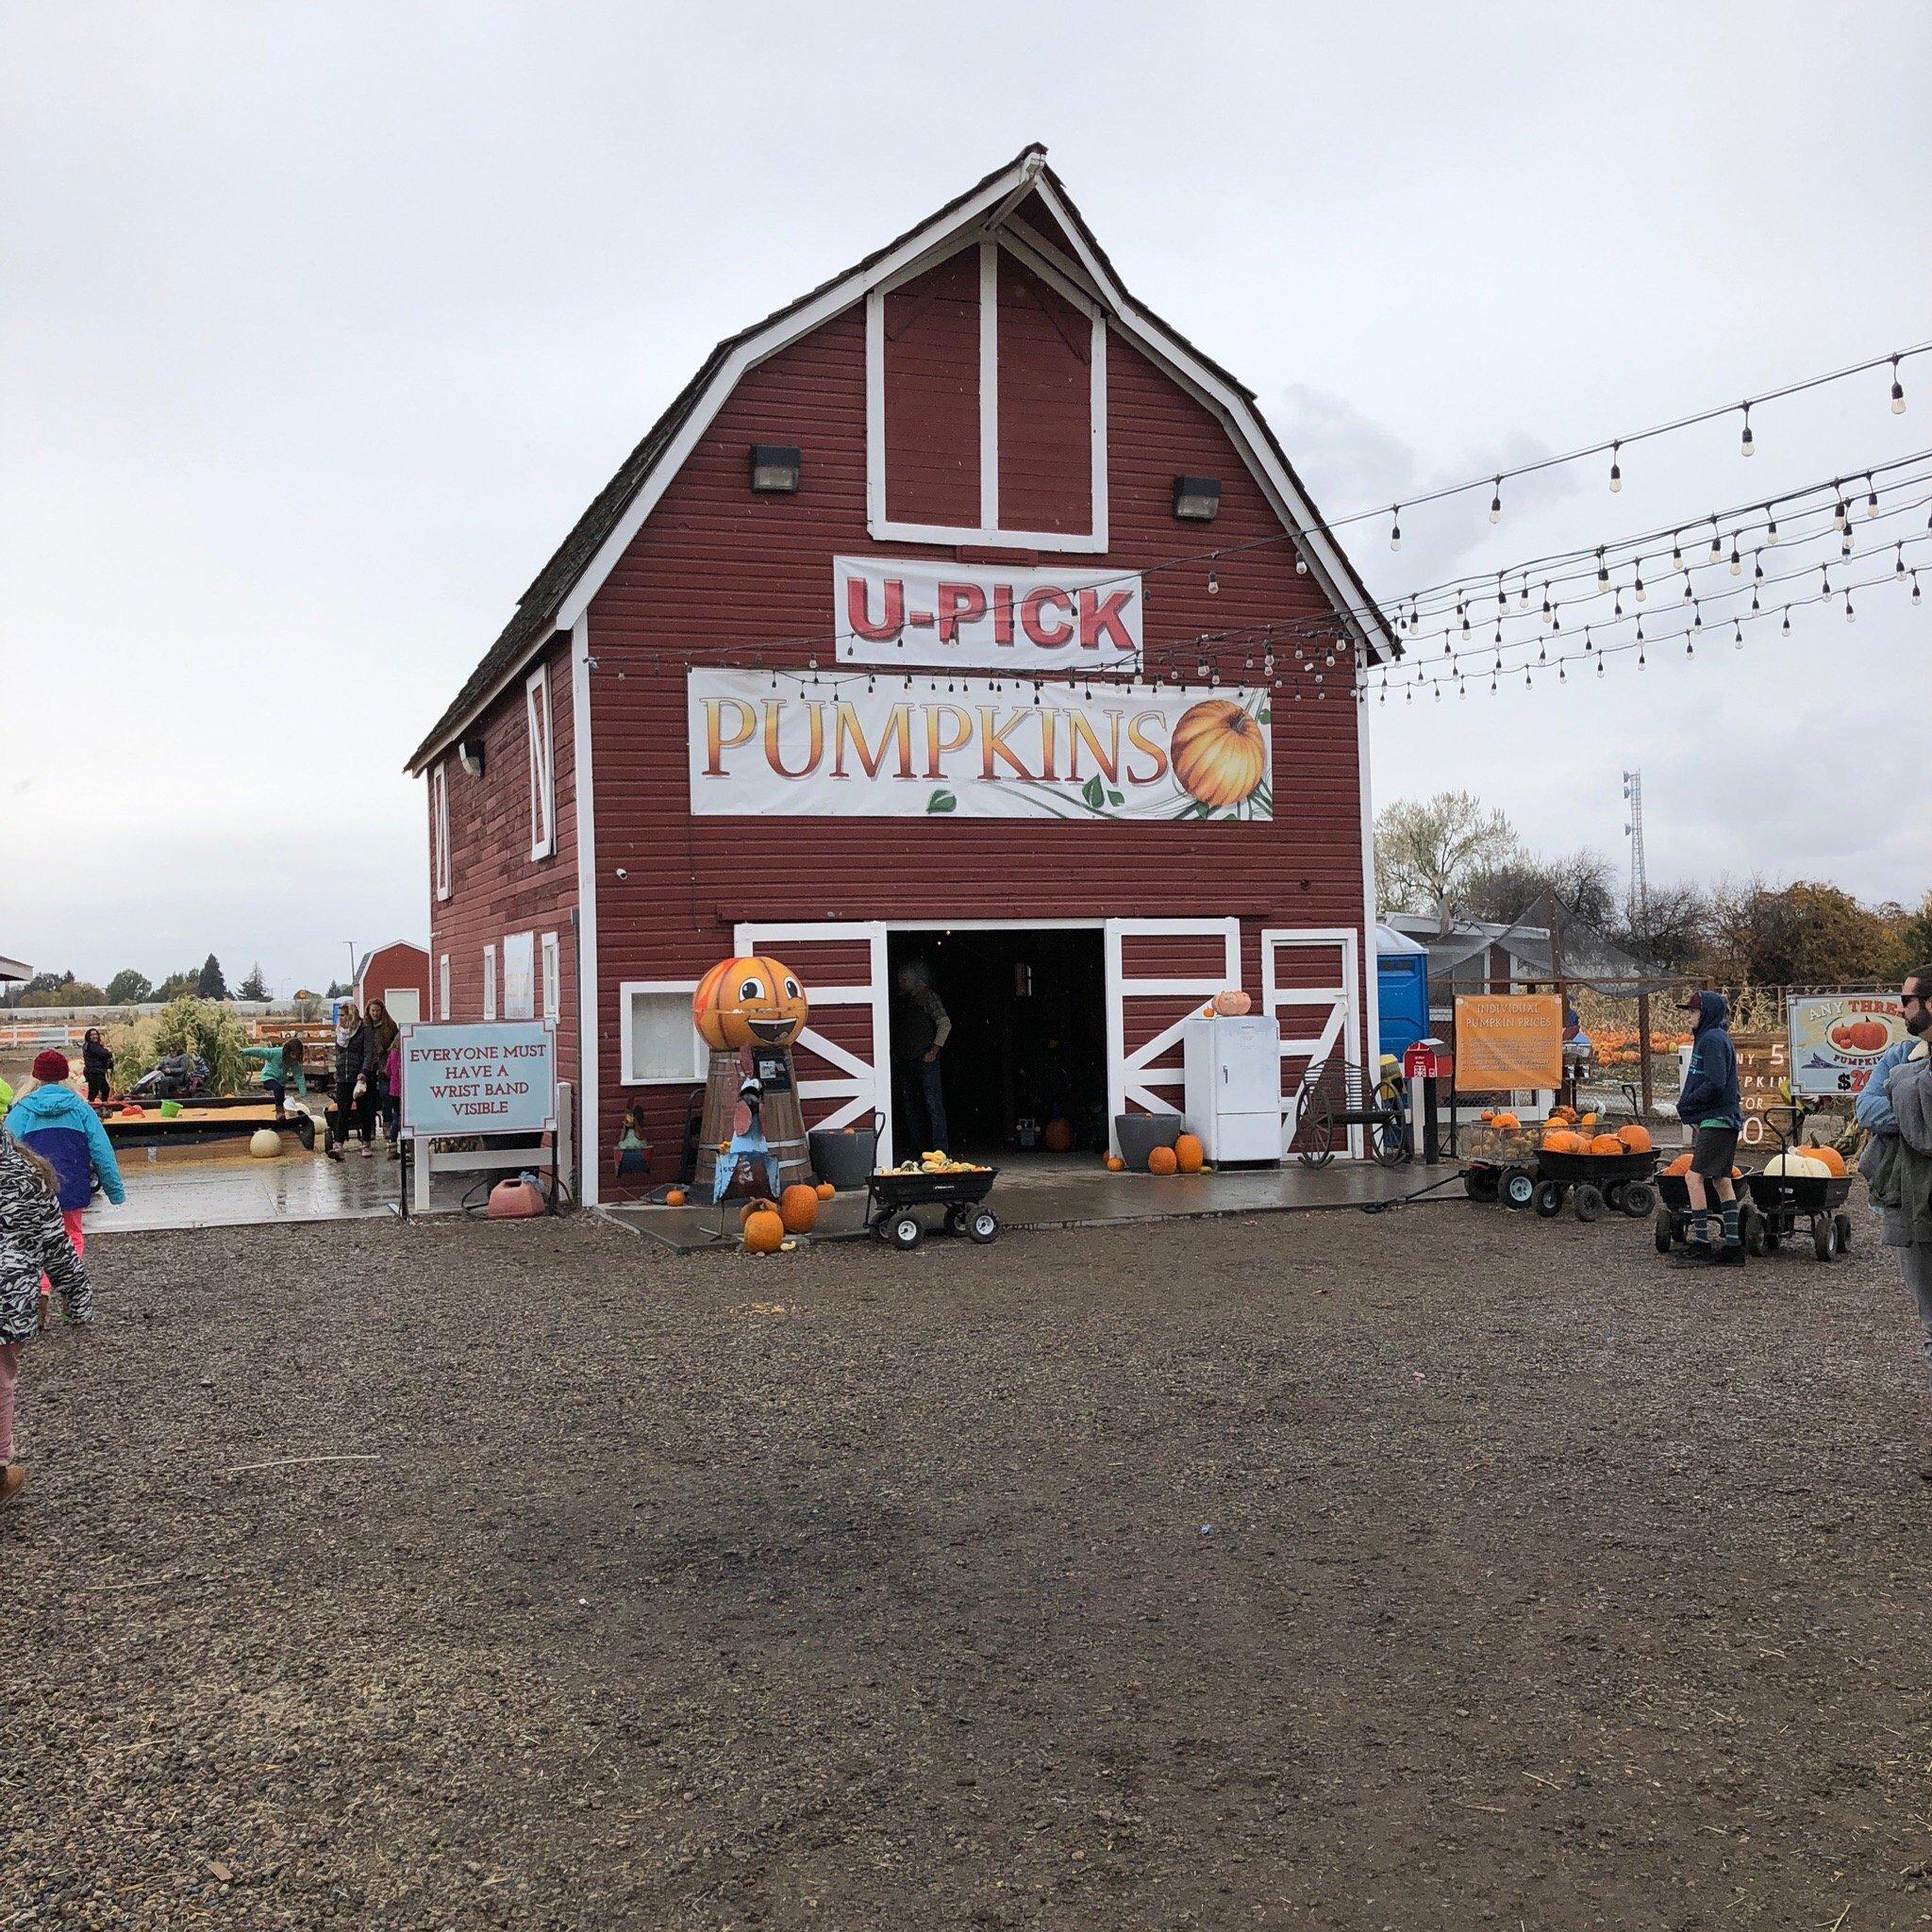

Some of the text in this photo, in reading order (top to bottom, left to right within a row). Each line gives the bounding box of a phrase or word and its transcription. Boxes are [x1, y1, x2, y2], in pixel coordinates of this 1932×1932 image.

[845, 575, 1140, 651] U-PICK
[699, 695, 1169, 786] PUMPKINS
[1477, 1003, 1541, 1014] INDIVIDUAL
[1809, 1000, 1905, 1022] ANY THRE
[1466, 1017, 1552, 1028] PUMPKIN PRICES
[409, 1043, 546, 1062] EVERYONE MUST
[1736, 1043, 1785, 1065] NY 5
[445, 1064, 509, 1079] HAVE A
[430, 1081, 529, 1099] WRIST BAND
[452, 1100, 509, 1116] VISIBLE
